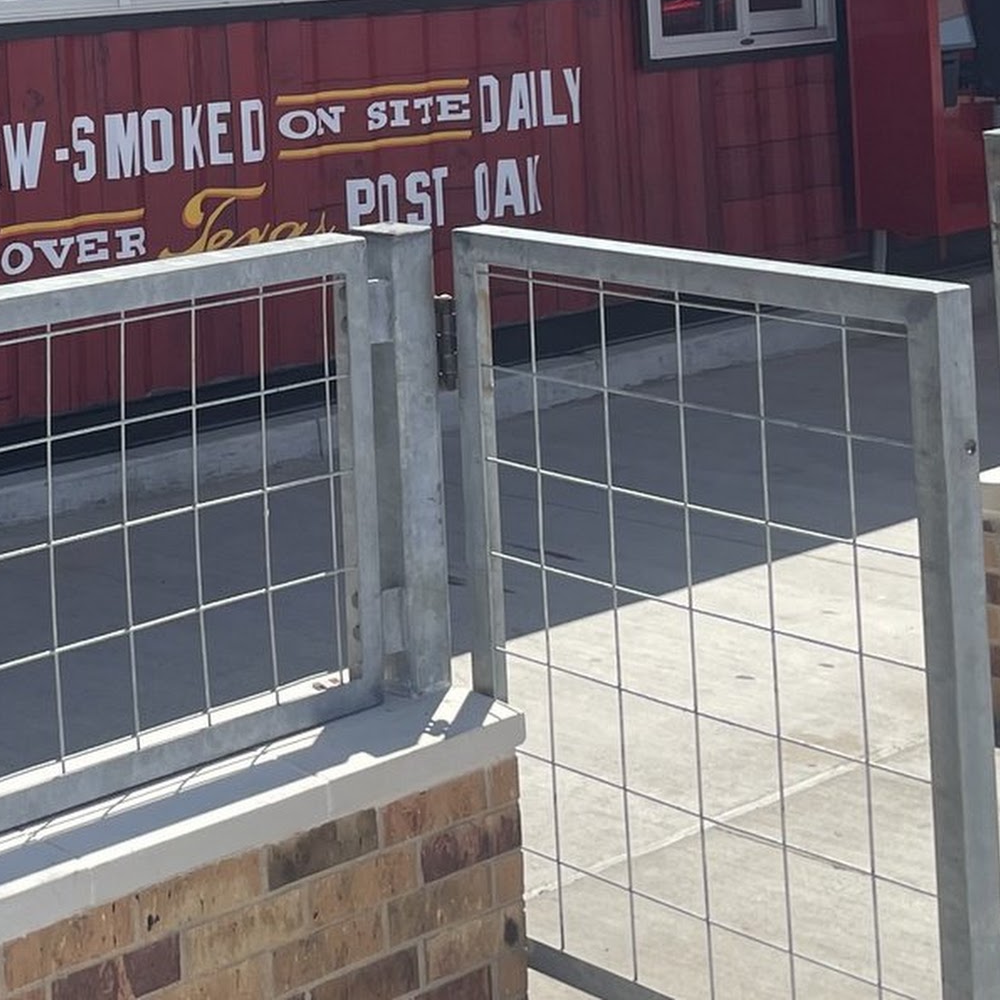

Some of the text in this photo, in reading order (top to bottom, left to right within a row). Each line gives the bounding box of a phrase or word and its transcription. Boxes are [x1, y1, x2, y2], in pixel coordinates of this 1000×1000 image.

[278, 106, 346, 140] ON
[367, 93, 472, 132] SITE
[479, 67, 581, 133] DAILY
[1, 226, 146, 275] OVER
[345, 166, 448, 230] POST
[474, 155, 542, 222] OAK
